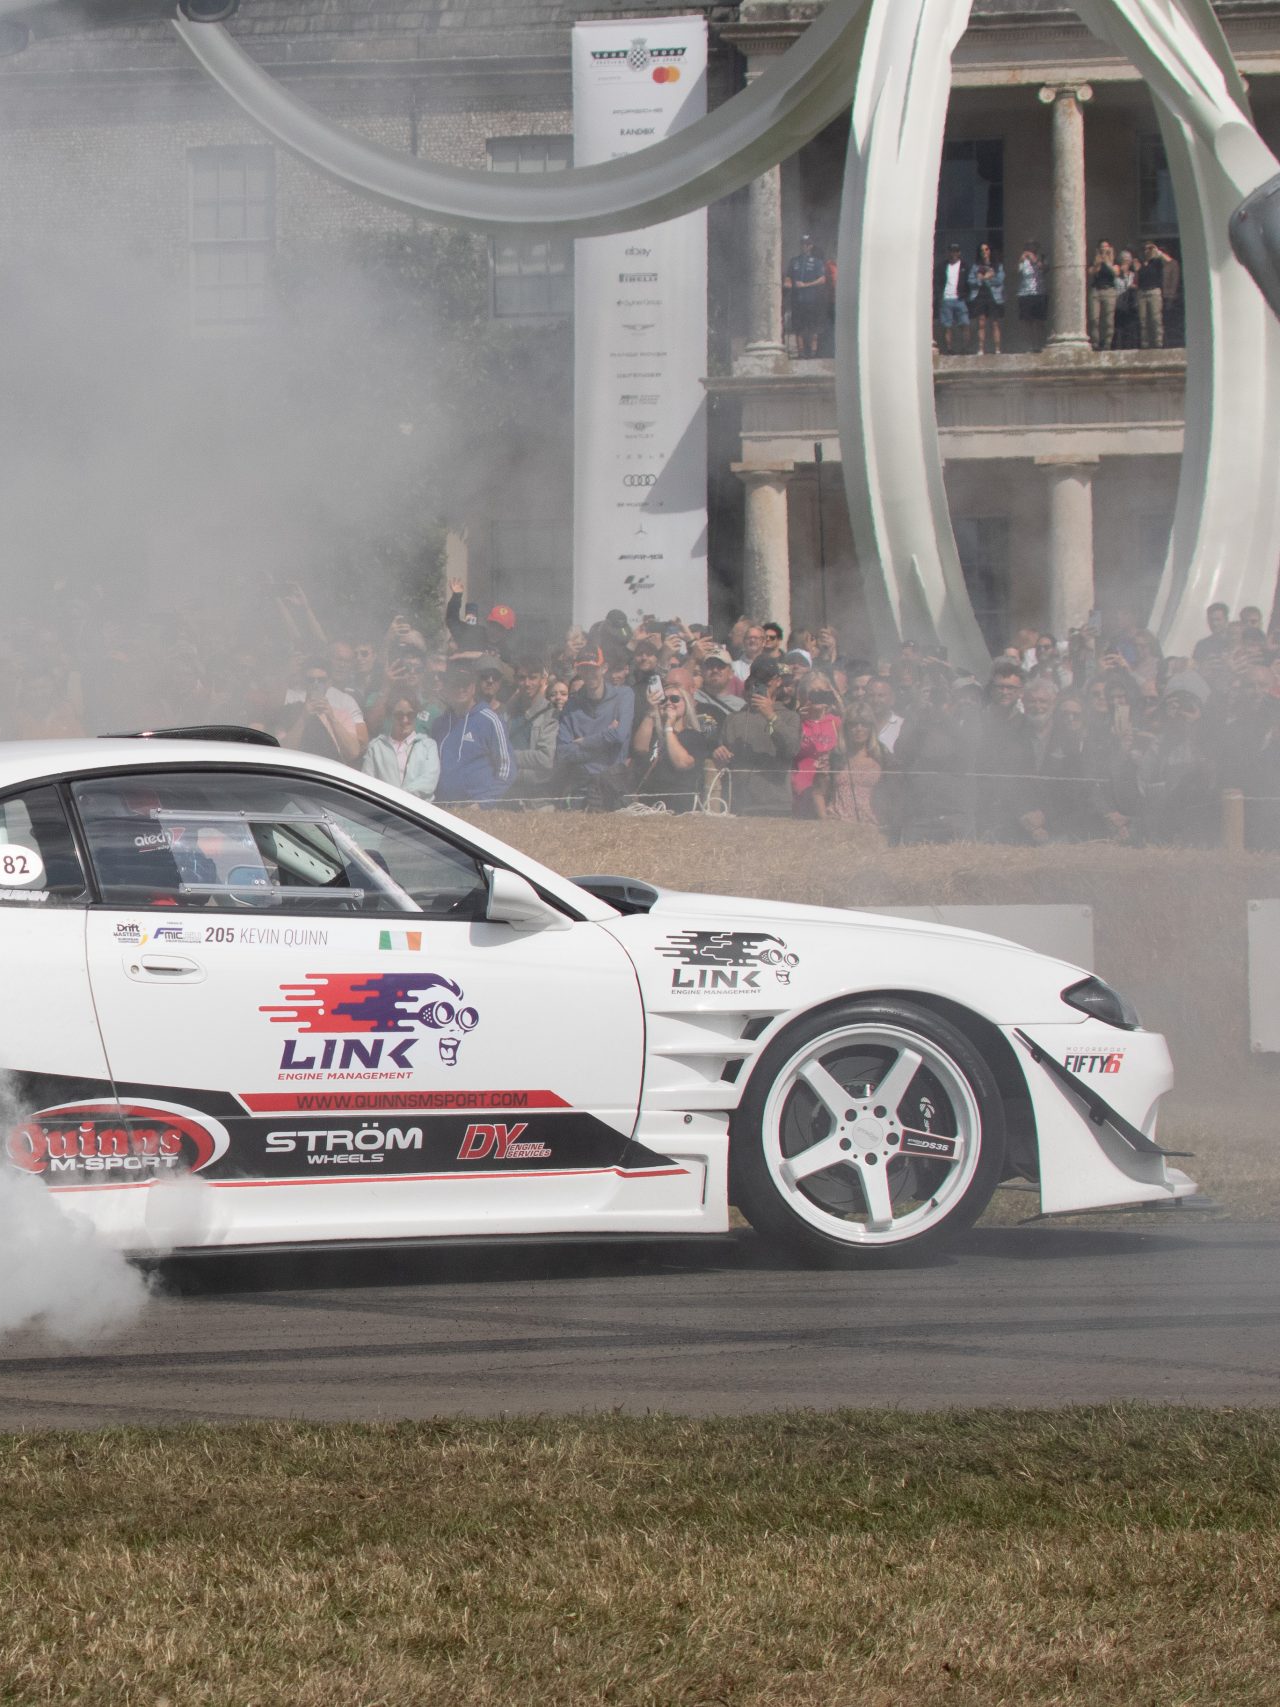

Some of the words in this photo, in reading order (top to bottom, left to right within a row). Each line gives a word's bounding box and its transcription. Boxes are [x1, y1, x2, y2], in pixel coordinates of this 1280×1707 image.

[117, 923, 140, 932] Drift
[204, 926, 235, 943] 205
[239, 928, 280, 944] KEVIN
[283, 929, 329, 947] QUINN
[671, 968, 762, 988] LINK
[279, 1038, 420, 1070] LINK
[1064, 1053, 1124, 1073] FIFTY6
[277, 1072, 324, 1081] ENGINE
[326, 1071, 414, 1081] MANAGEMENT
[296, 1092, 529, 1109] WWW.QUINNSMSPORT.COM
[265, 1122, 423, 1153] STRÖM
[456, 1122, 529, 1160] DY
[921, 1140, 950, 1151] DS35
[5, 1121, 183, 1174] Quinns
[505, 1149, 552, 1159] SERVICES
[506, 1142, 546, 1151] ENGINE
[51, 1156, 179, 1172] M-SPORT
[307, 1153, 385, 1165] WHEELS
